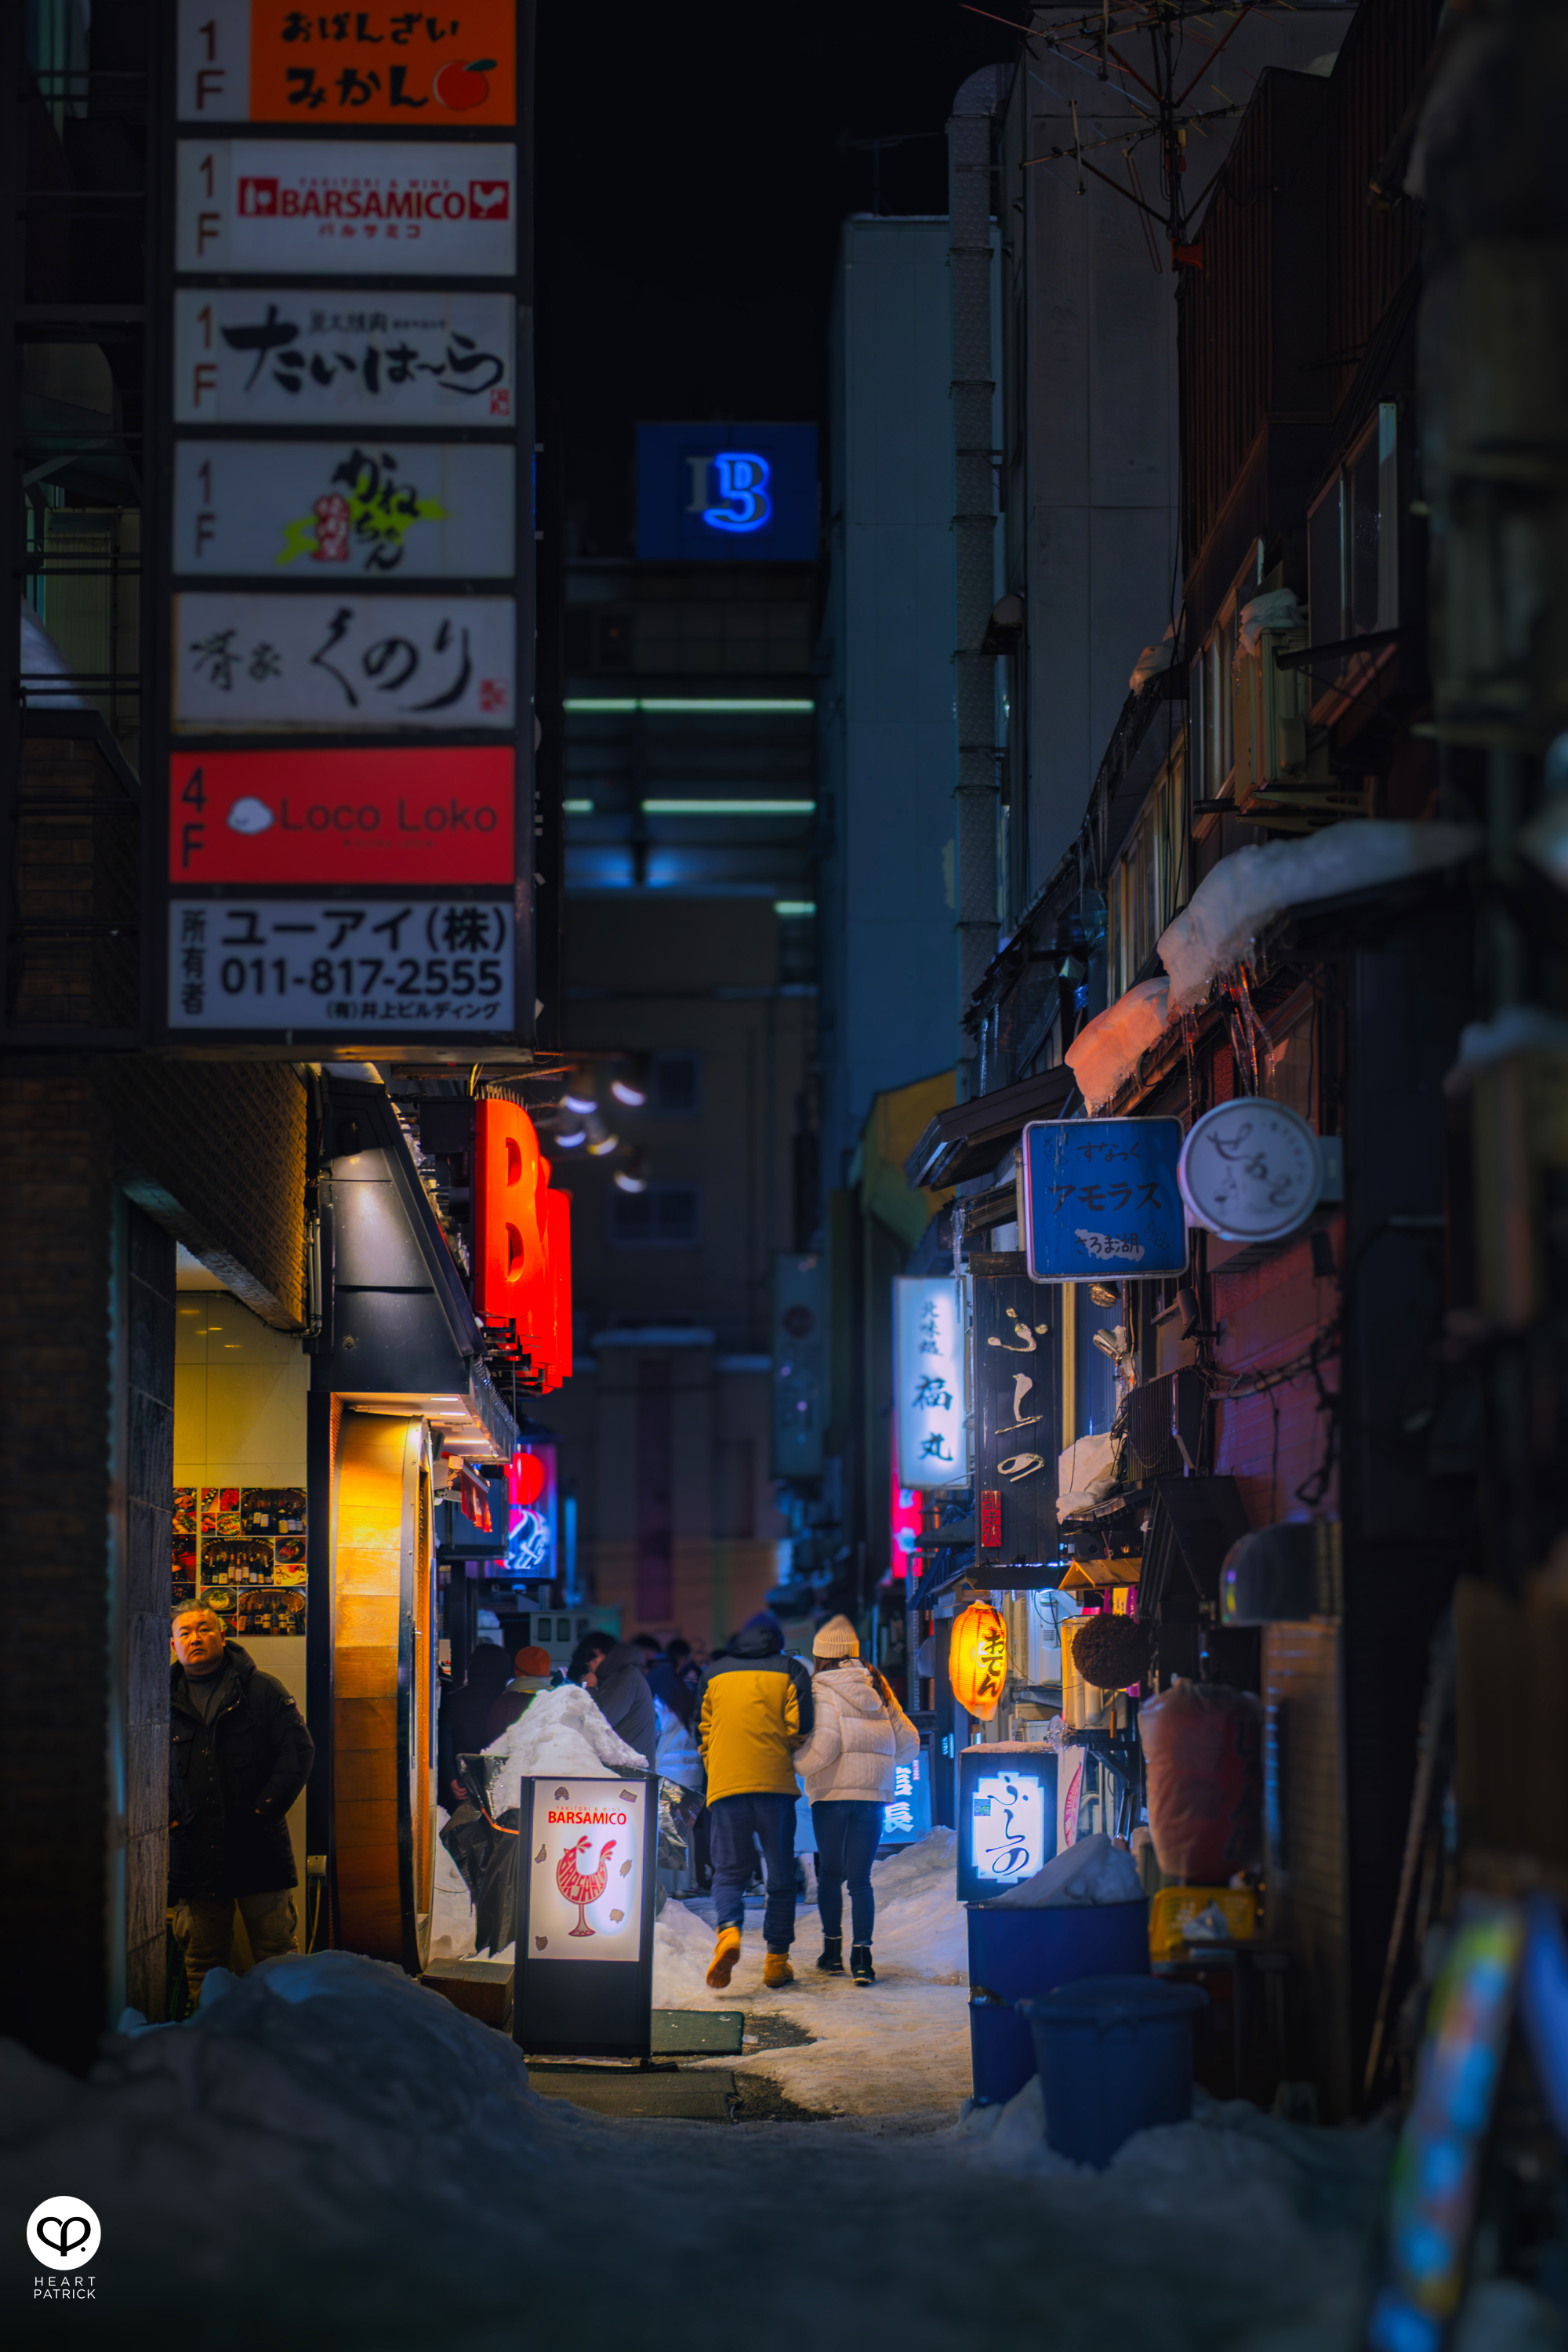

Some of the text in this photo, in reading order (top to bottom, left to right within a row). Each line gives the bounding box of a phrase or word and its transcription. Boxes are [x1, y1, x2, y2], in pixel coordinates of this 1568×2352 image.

[281, 11, 459, 44] おばんざい
[286, 65, 429, 109] みかん
[281, 189, 466, 220] BARSAMICO
[319, 223, 421, 239] バルサミコ
[281, 797, 498, 833] Loco Loko
[181, 909, 206, 1014] 所有者
[220, 958, 503, 996] 011-817-2555
[1077, 1142, 1140, 1163] すなっく
[1049, 1181, 1162, 1214] アモラス
[1075, 1232, 1139, 1255] さろま湖
[987, 1307, 1049, 1483] ふらの
[912, 1375, 953, 1462] 福丸
[548, 1811, 626, 1825] BARSAMICO
[985, 1774, 1032, 1876] ふらの
